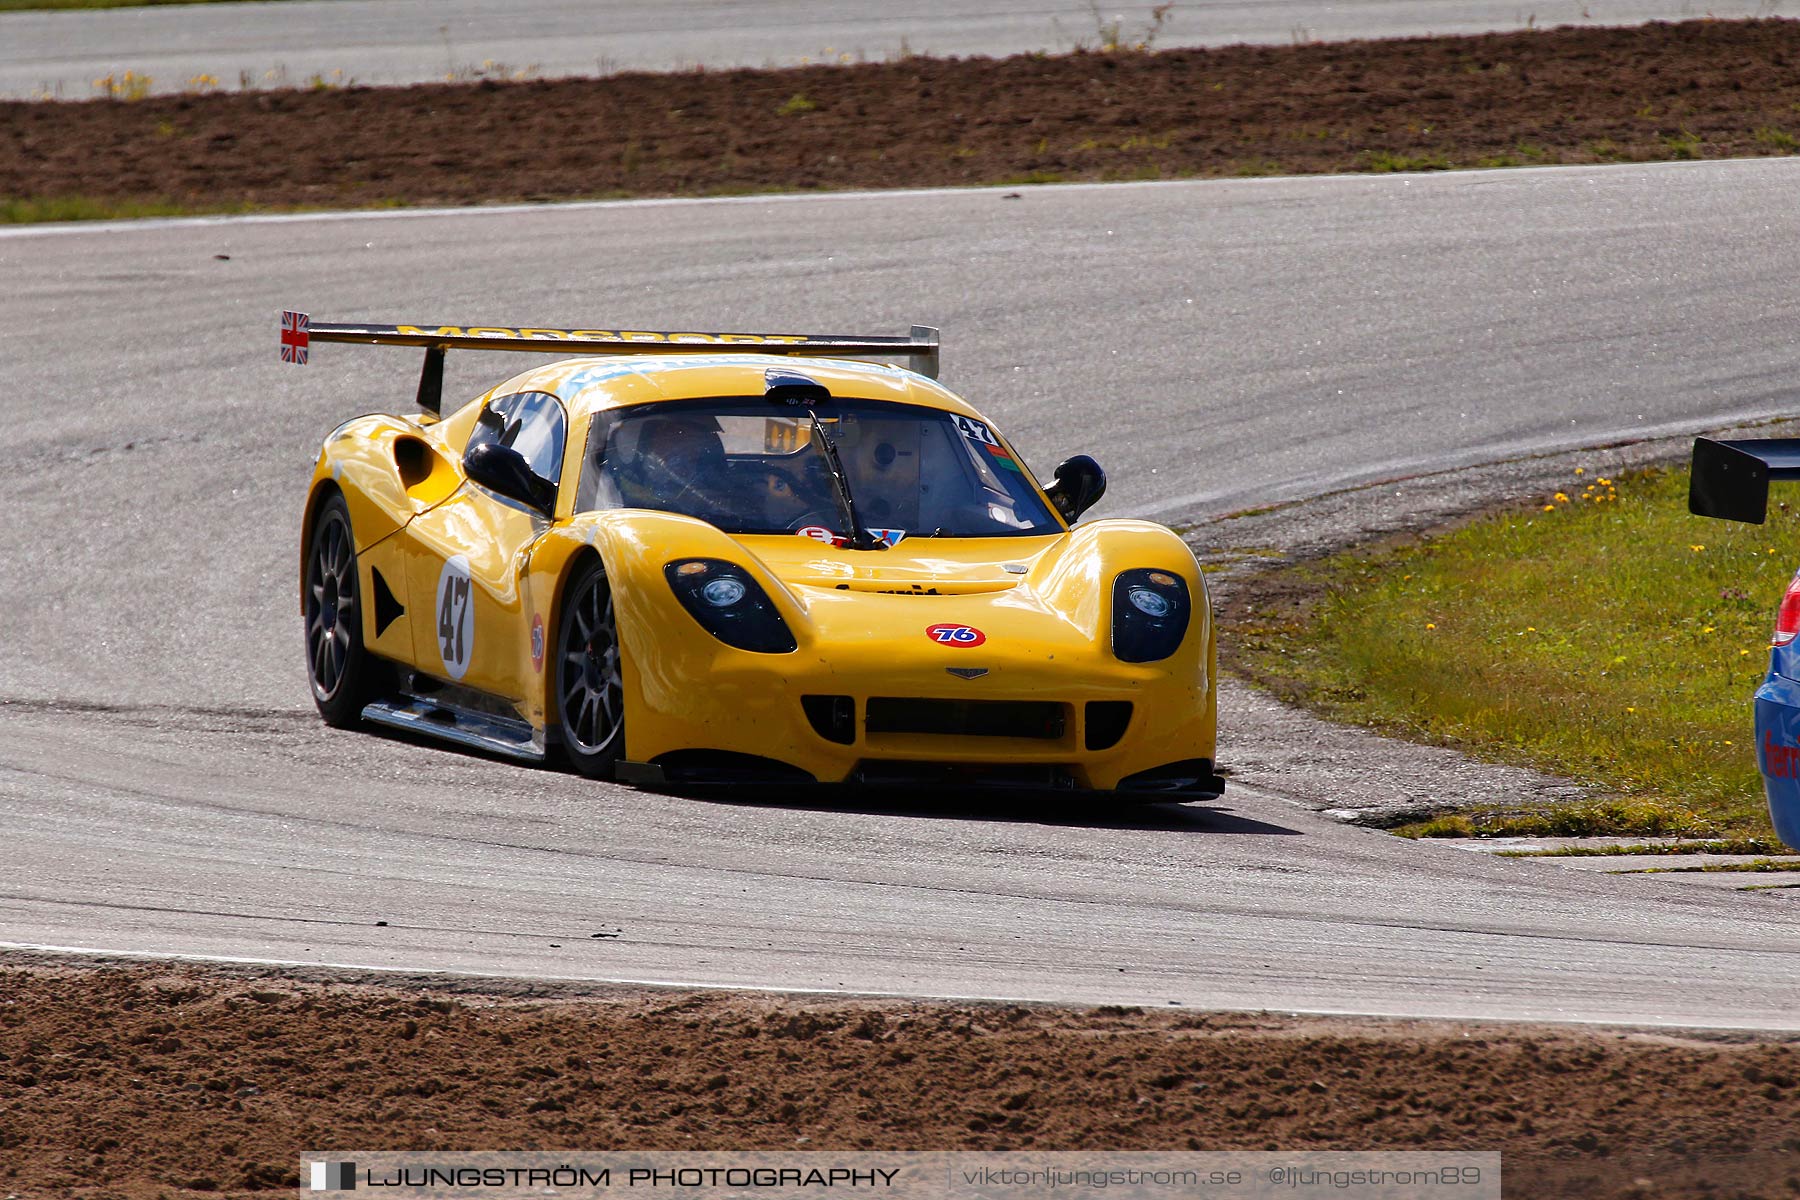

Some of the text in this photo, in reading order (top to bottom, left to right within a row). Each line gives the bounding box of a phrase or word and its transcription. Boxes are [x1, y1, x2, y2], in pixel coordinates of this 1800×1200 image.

[958, 416, 993, 443] 47
[440, 575, 470, 665] 47
[932, 627, 977, 642] 76
[1765, 729, 1800, 780] ferr
